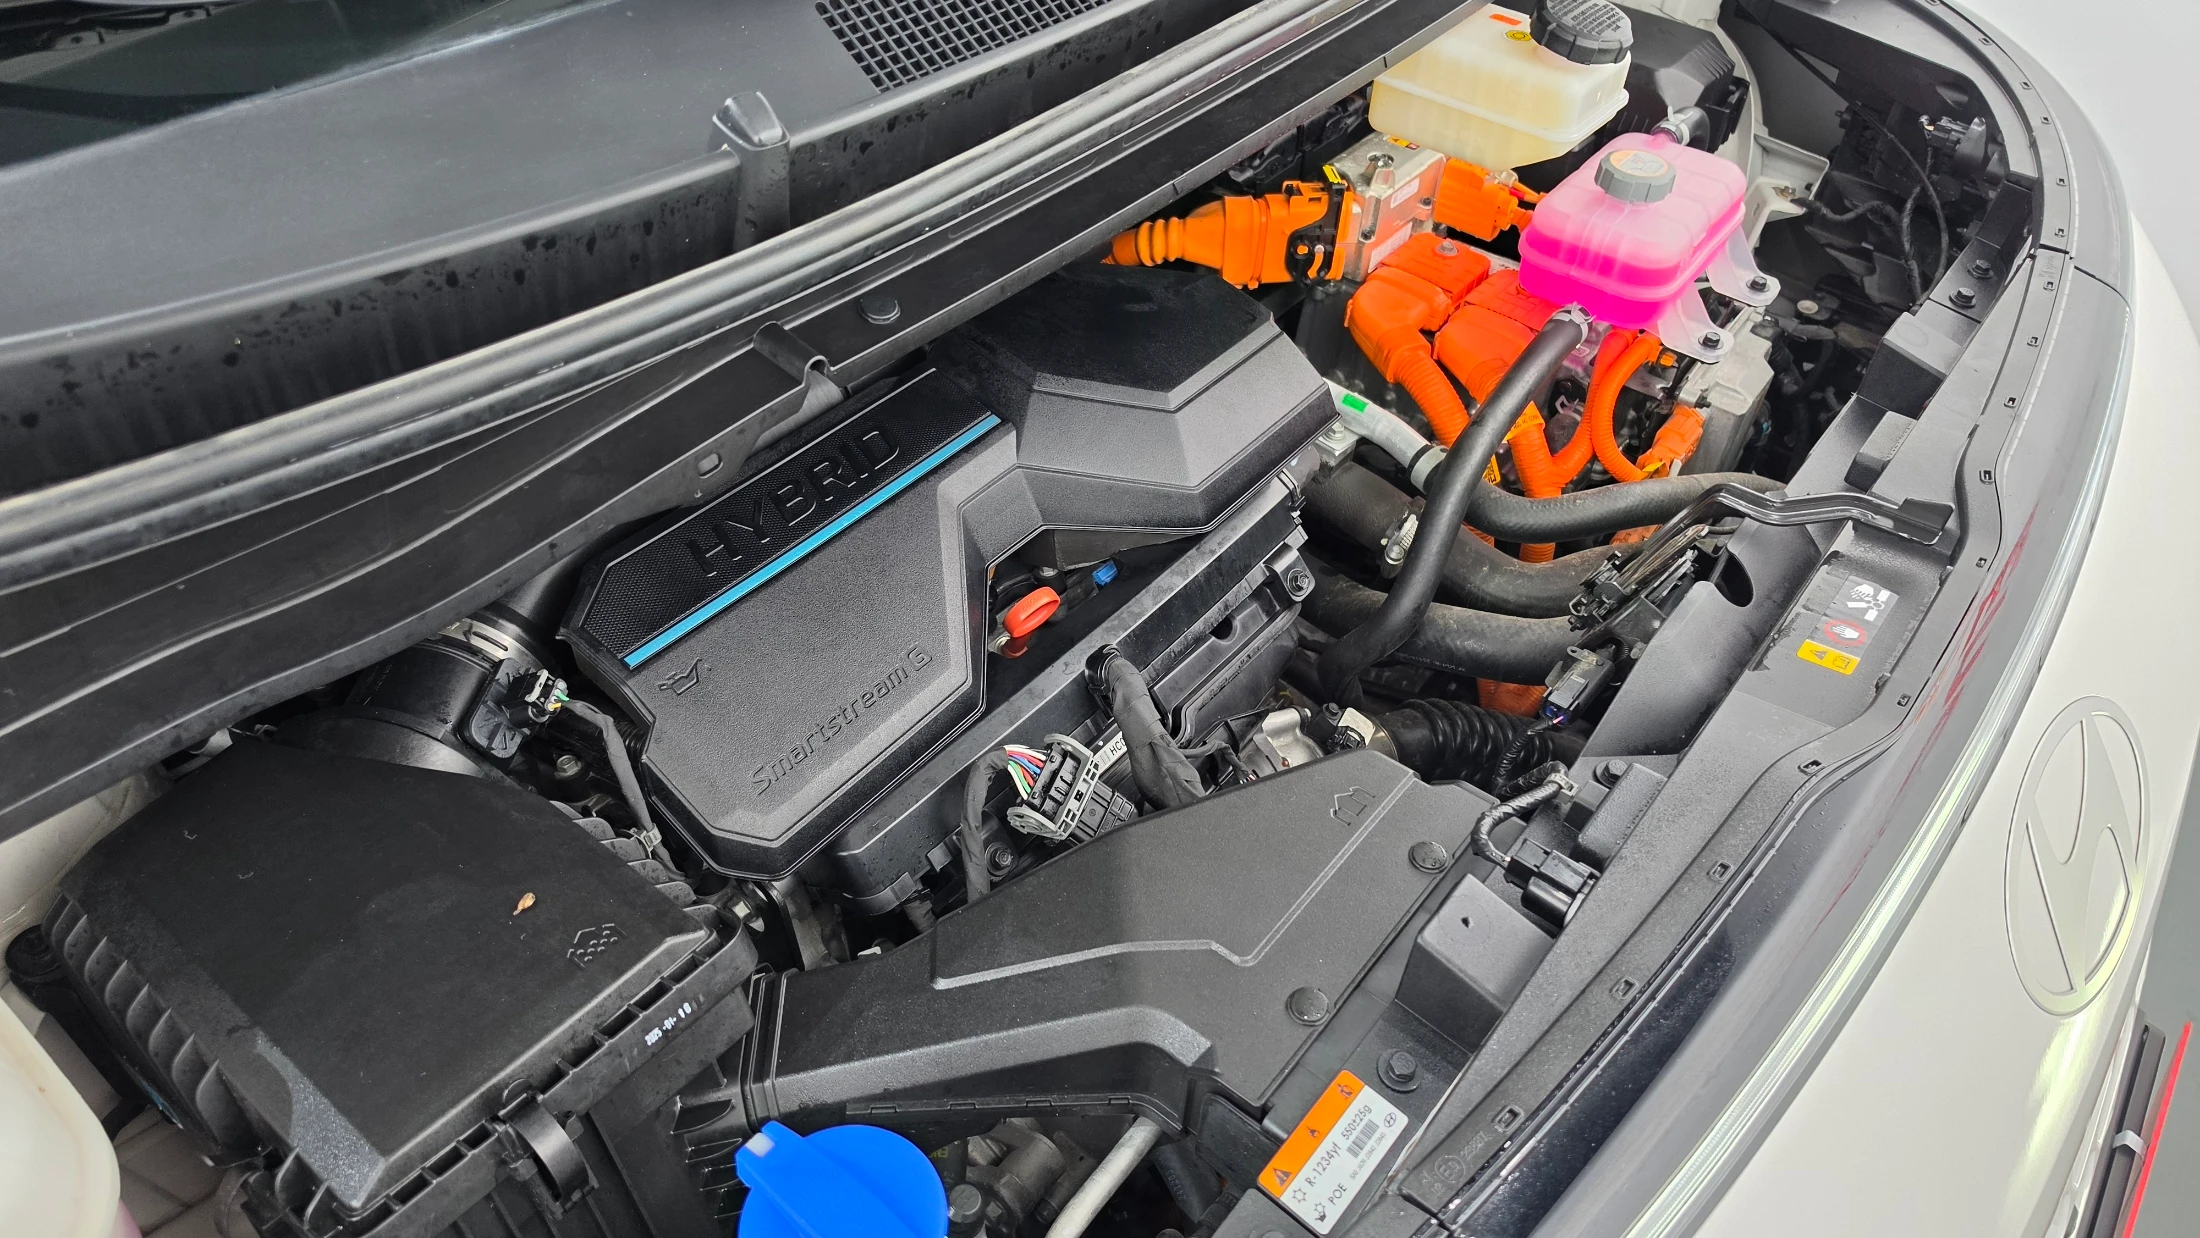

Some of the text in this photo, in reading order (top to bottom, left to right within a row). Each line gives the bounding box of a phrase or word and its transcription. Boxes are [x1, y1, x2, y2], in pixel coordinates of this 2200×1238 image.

[687, 427, 899, 577] HYBRID
[752, 646, 933, 796] Smartstream G
[1304, 1104, 1373, 1187] R-1234yf 550±25g
[1327, 1182, 1348, 1206] POE
